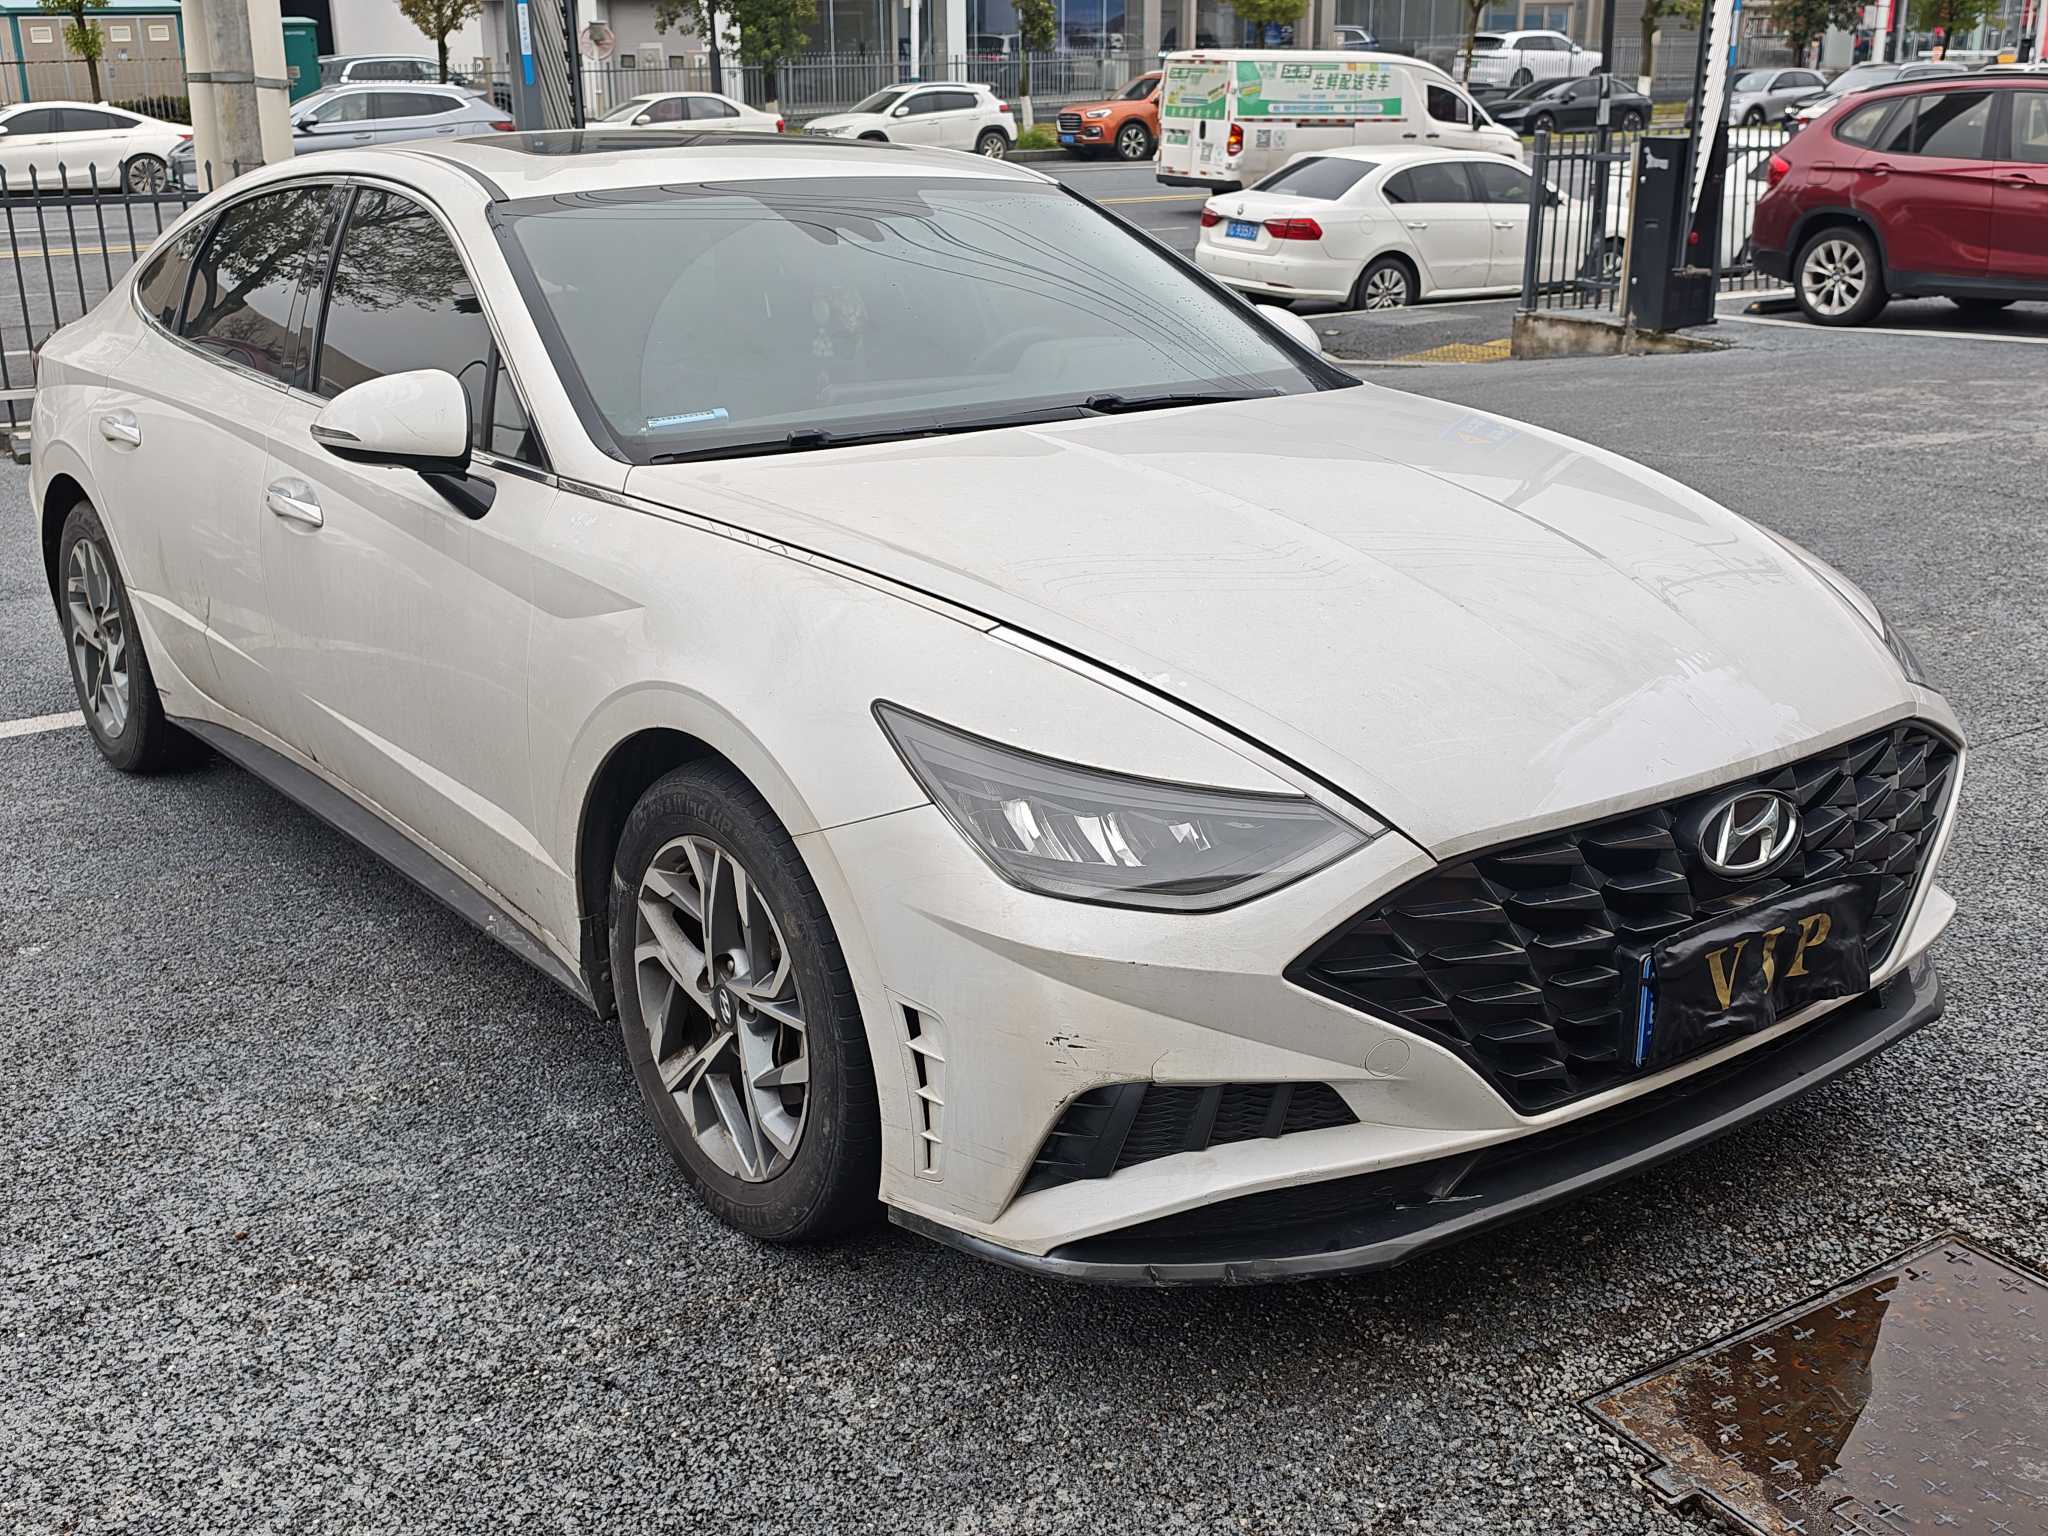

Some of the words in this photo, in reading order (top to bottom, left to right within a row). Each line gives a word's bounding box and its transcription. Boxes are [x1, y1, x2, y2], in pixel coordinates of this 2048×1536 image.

[1312, 73, 1390, 91] 生鲜配送专车
[1705, 913, 1831, 1010] VIP
